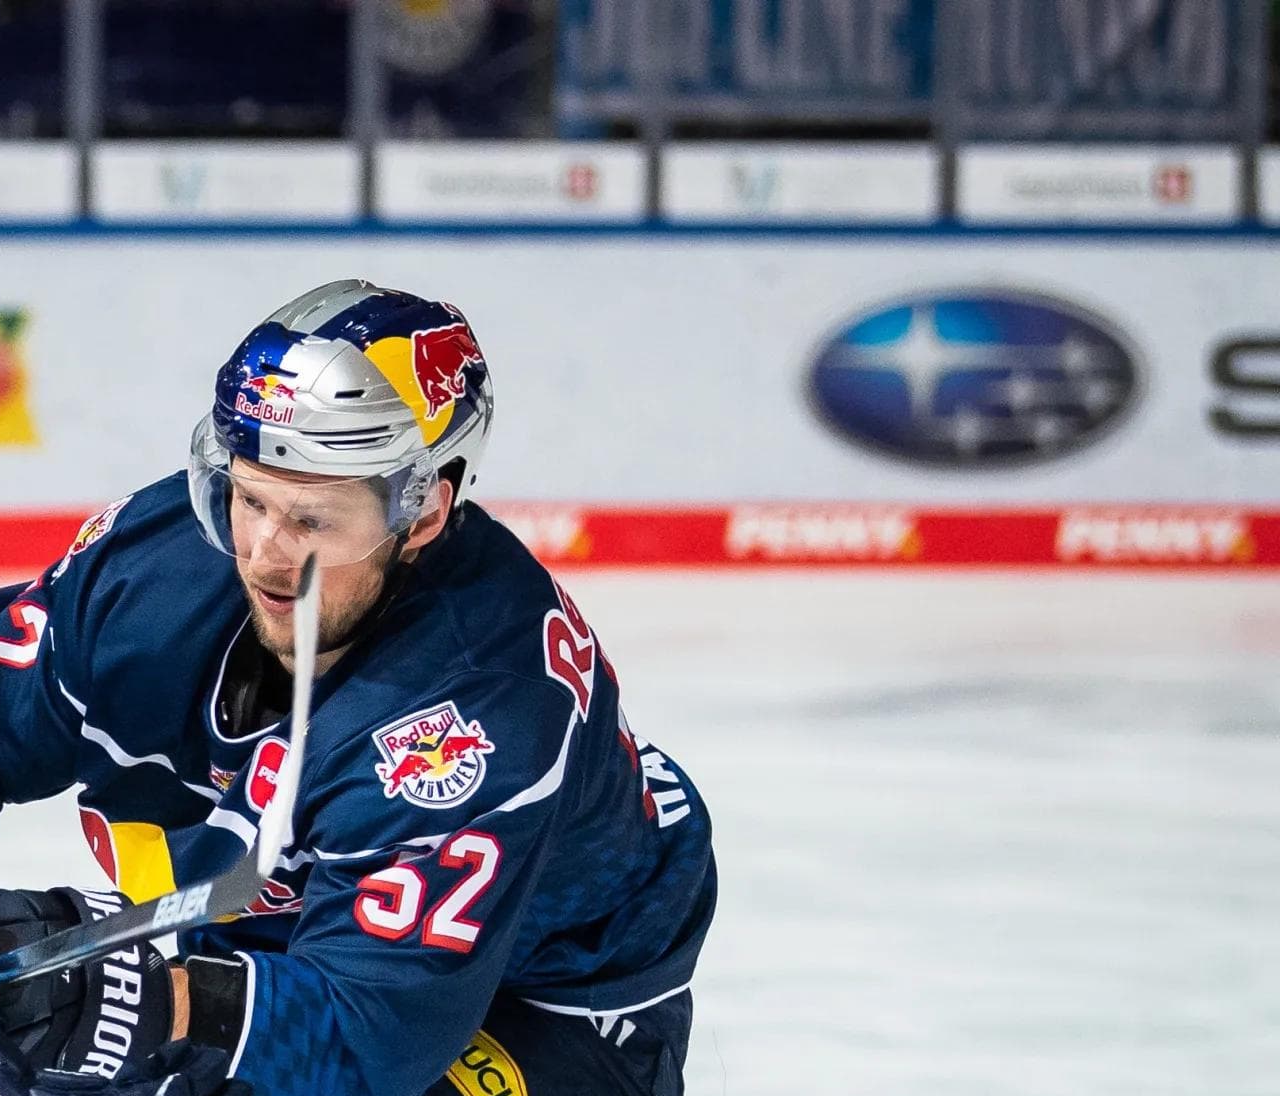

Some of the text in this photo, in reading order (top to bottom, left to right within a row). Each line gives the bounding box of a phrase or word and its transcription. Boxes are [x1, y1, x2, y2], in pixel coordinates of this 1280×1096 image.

[235, 393, 295, 425] Red Bull
[726, 512, 910, 556] PENNY
[1057, 512, 1240, 558] PENNY
[385, 711, 454, 752] Red Bull
[415, 760, 478, 799] MÜNCHEN
[353, 828, 504, 954] 52
